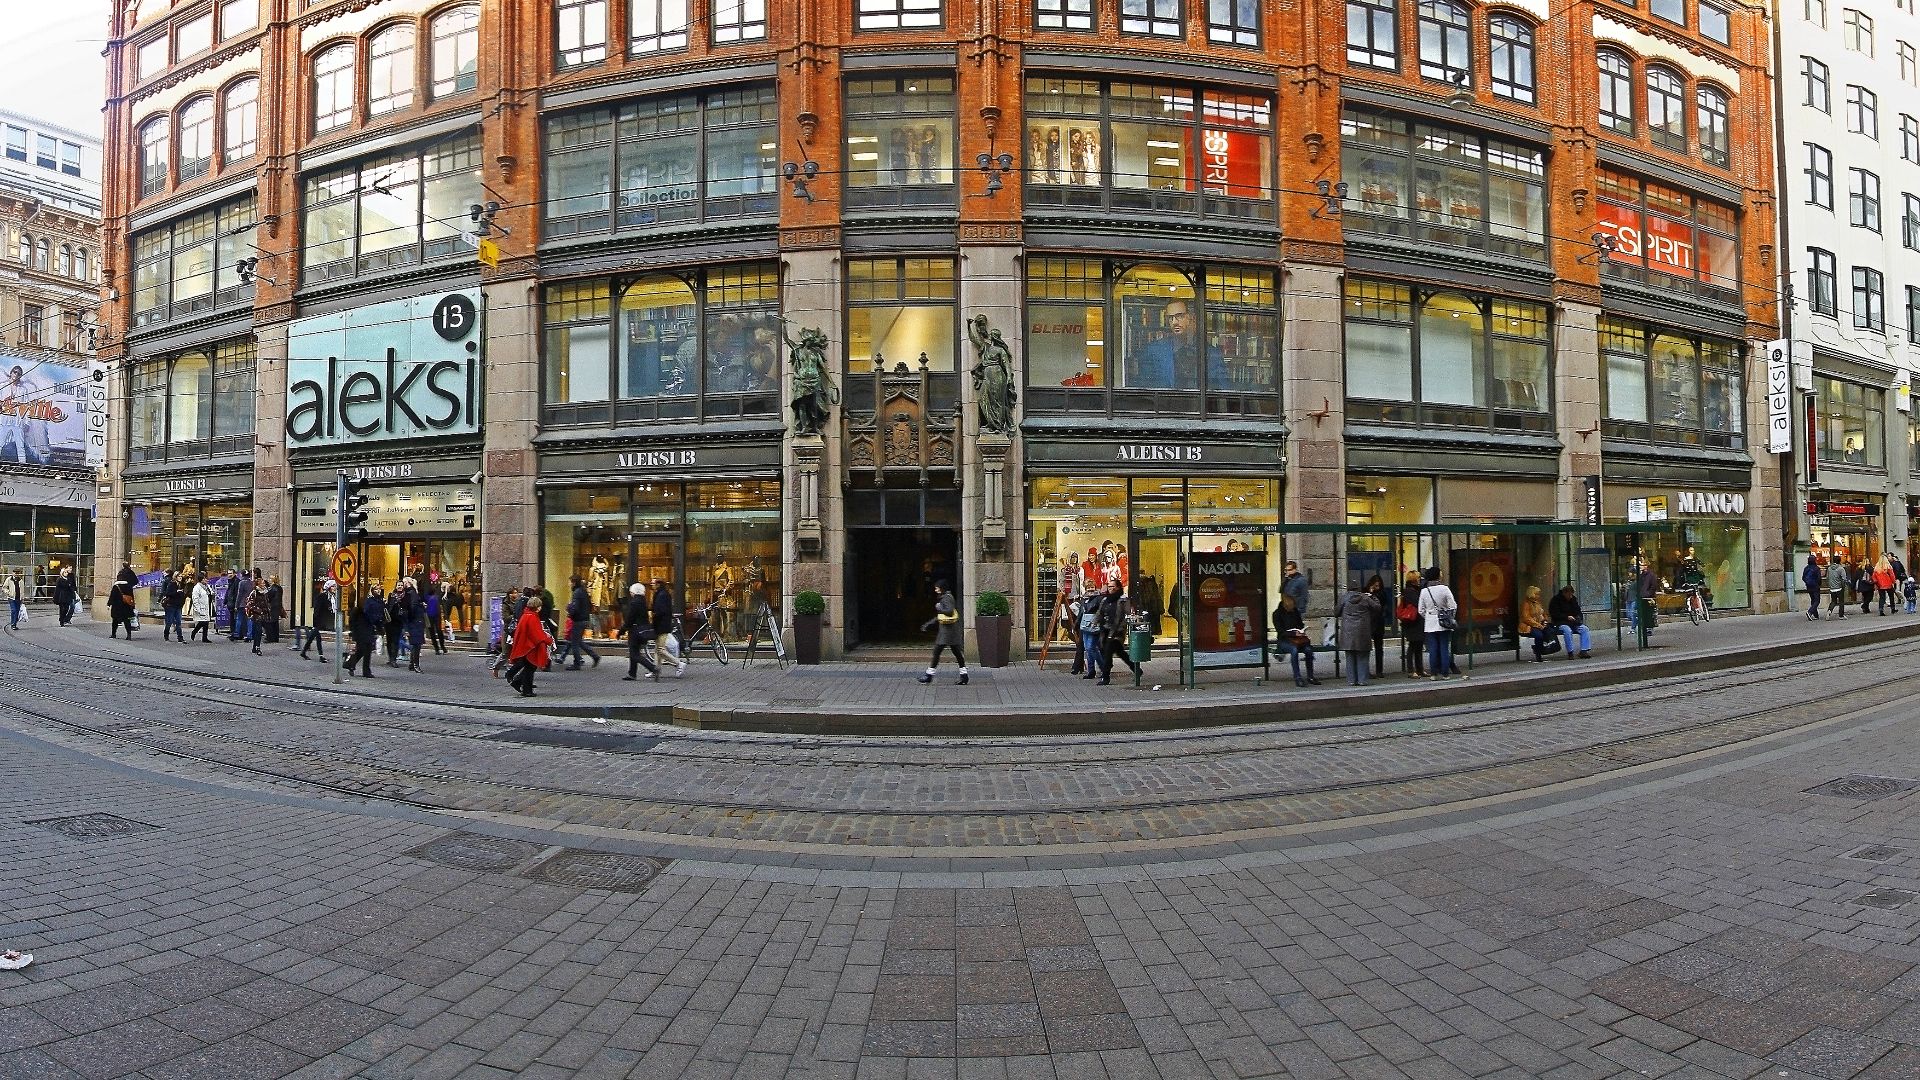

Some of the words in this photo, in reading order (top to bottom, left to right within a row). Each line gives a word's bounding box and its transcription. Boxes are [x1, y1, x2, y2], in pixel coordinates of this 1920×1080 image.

[1600, 221, 1693, 269] ESPRIT
[1031, 324, 1082, 333] BLEND
[286, 340, 477, 442] aleksi
[442, 304, 464, 329] 13
[1769, 364, 1788, 430] aleksi
[88, 385, 105, 446] aleksi
[615, 451, 675, 467] ALEKSI
[680, 450, 696, 465] 13
[1115, 445, 1181, 460] ALEKSI
[1186, 446, 1202, 460] 13
[352, 465, 397, 478] ALEKSI
[400, 463, 412, 477] 13
[164, 479, 196, 491] ALEKSI
[197, 478, 206, 489] 13
[1678, 492, 1745, 513] MANGO
